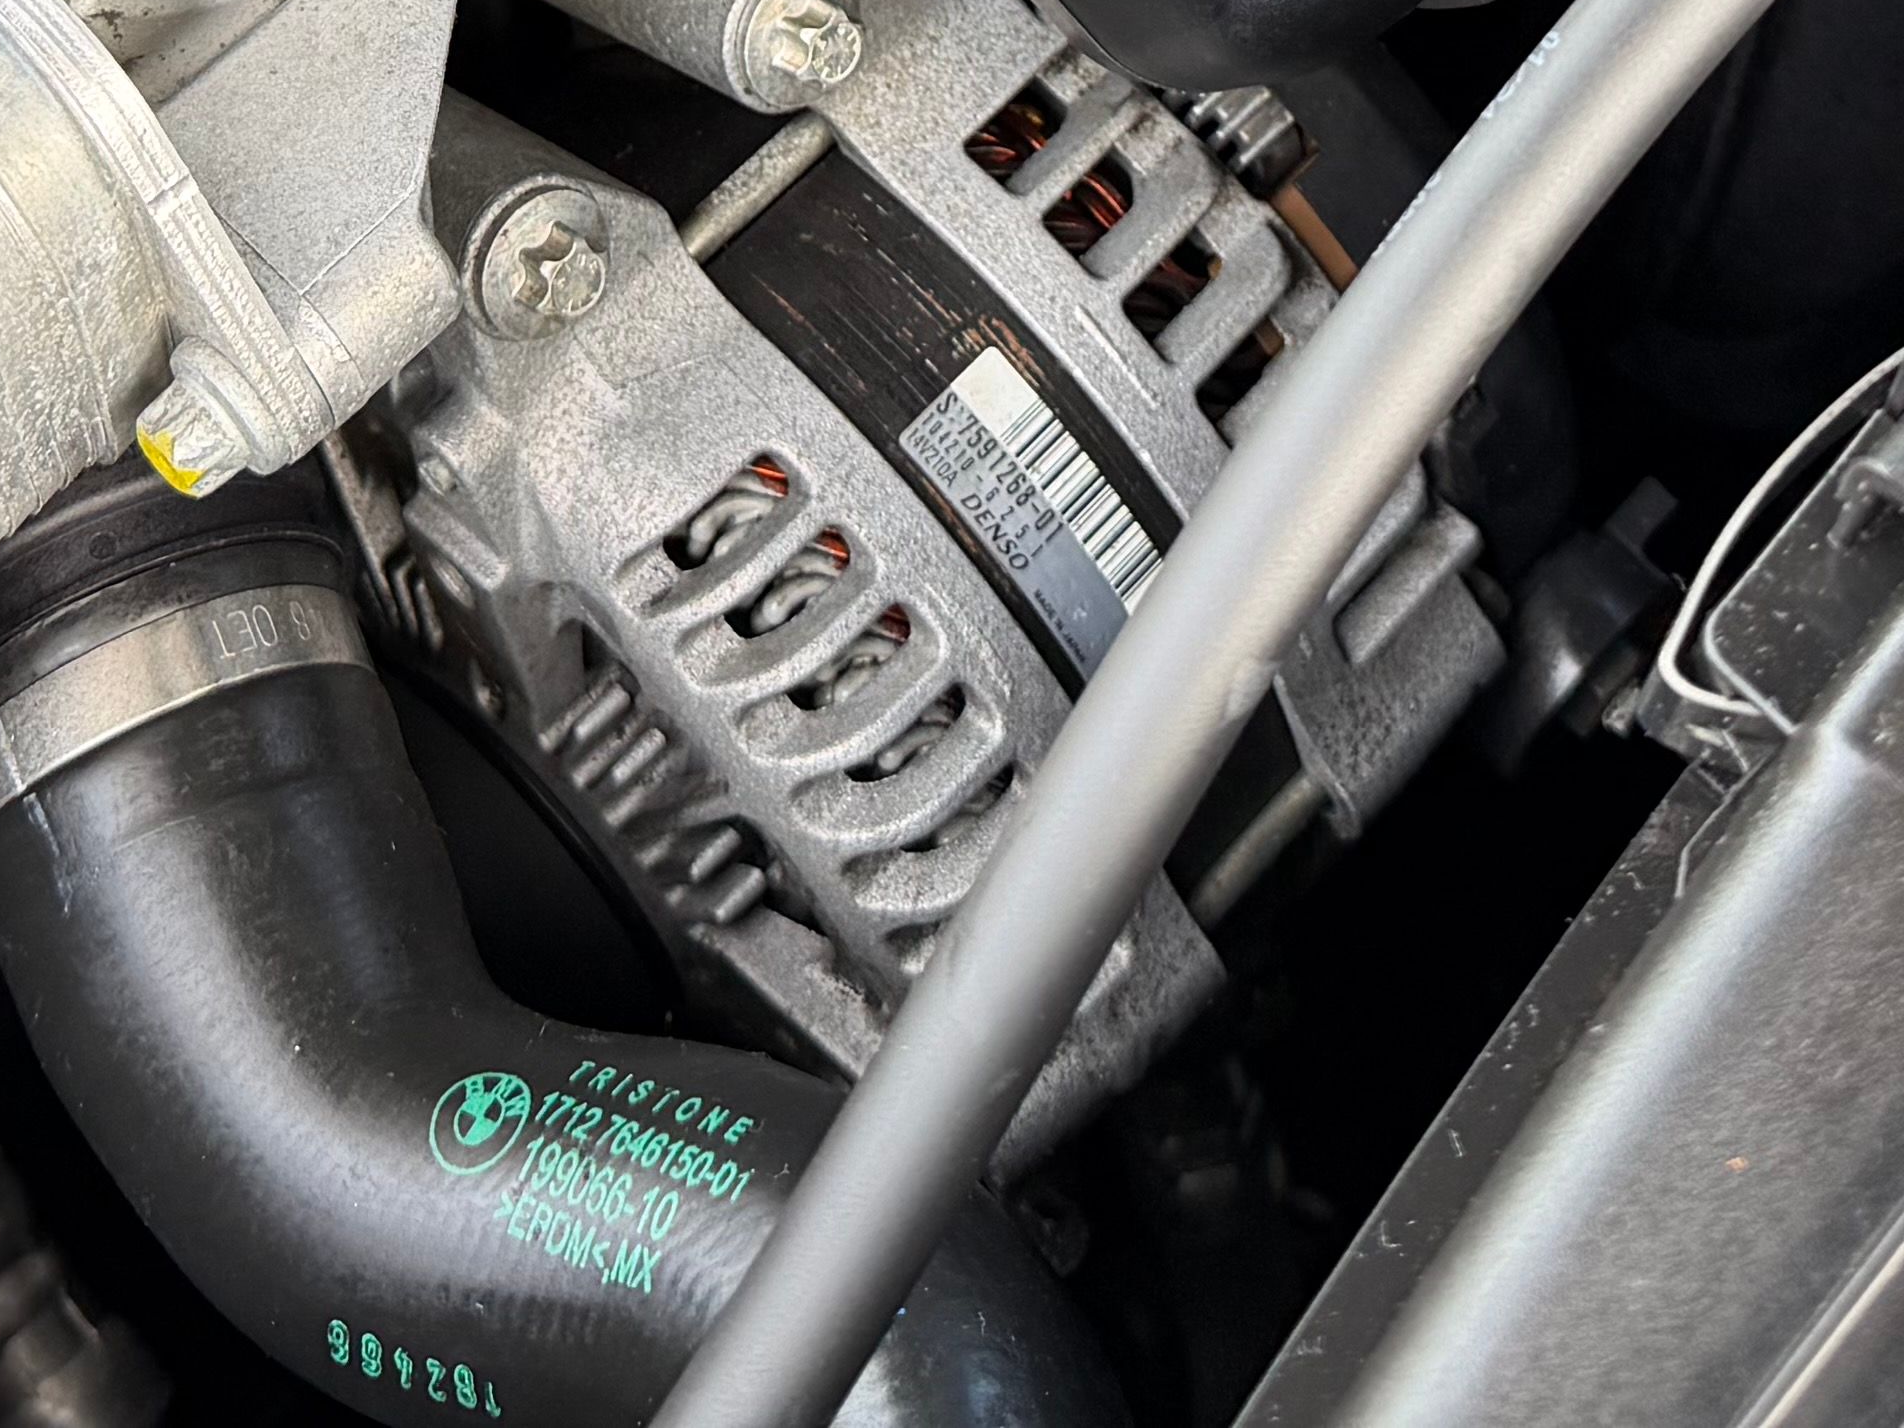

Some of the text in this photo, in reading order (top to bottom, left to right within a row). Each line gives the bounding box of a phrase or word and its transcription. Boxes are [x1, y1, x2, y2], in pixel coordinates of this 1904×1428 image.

[960, 494, 1028, 574] DENSO
[568, 1060, 756, 1144] TRISTONE
[521, 1136, 679, 1241] 199066-10
